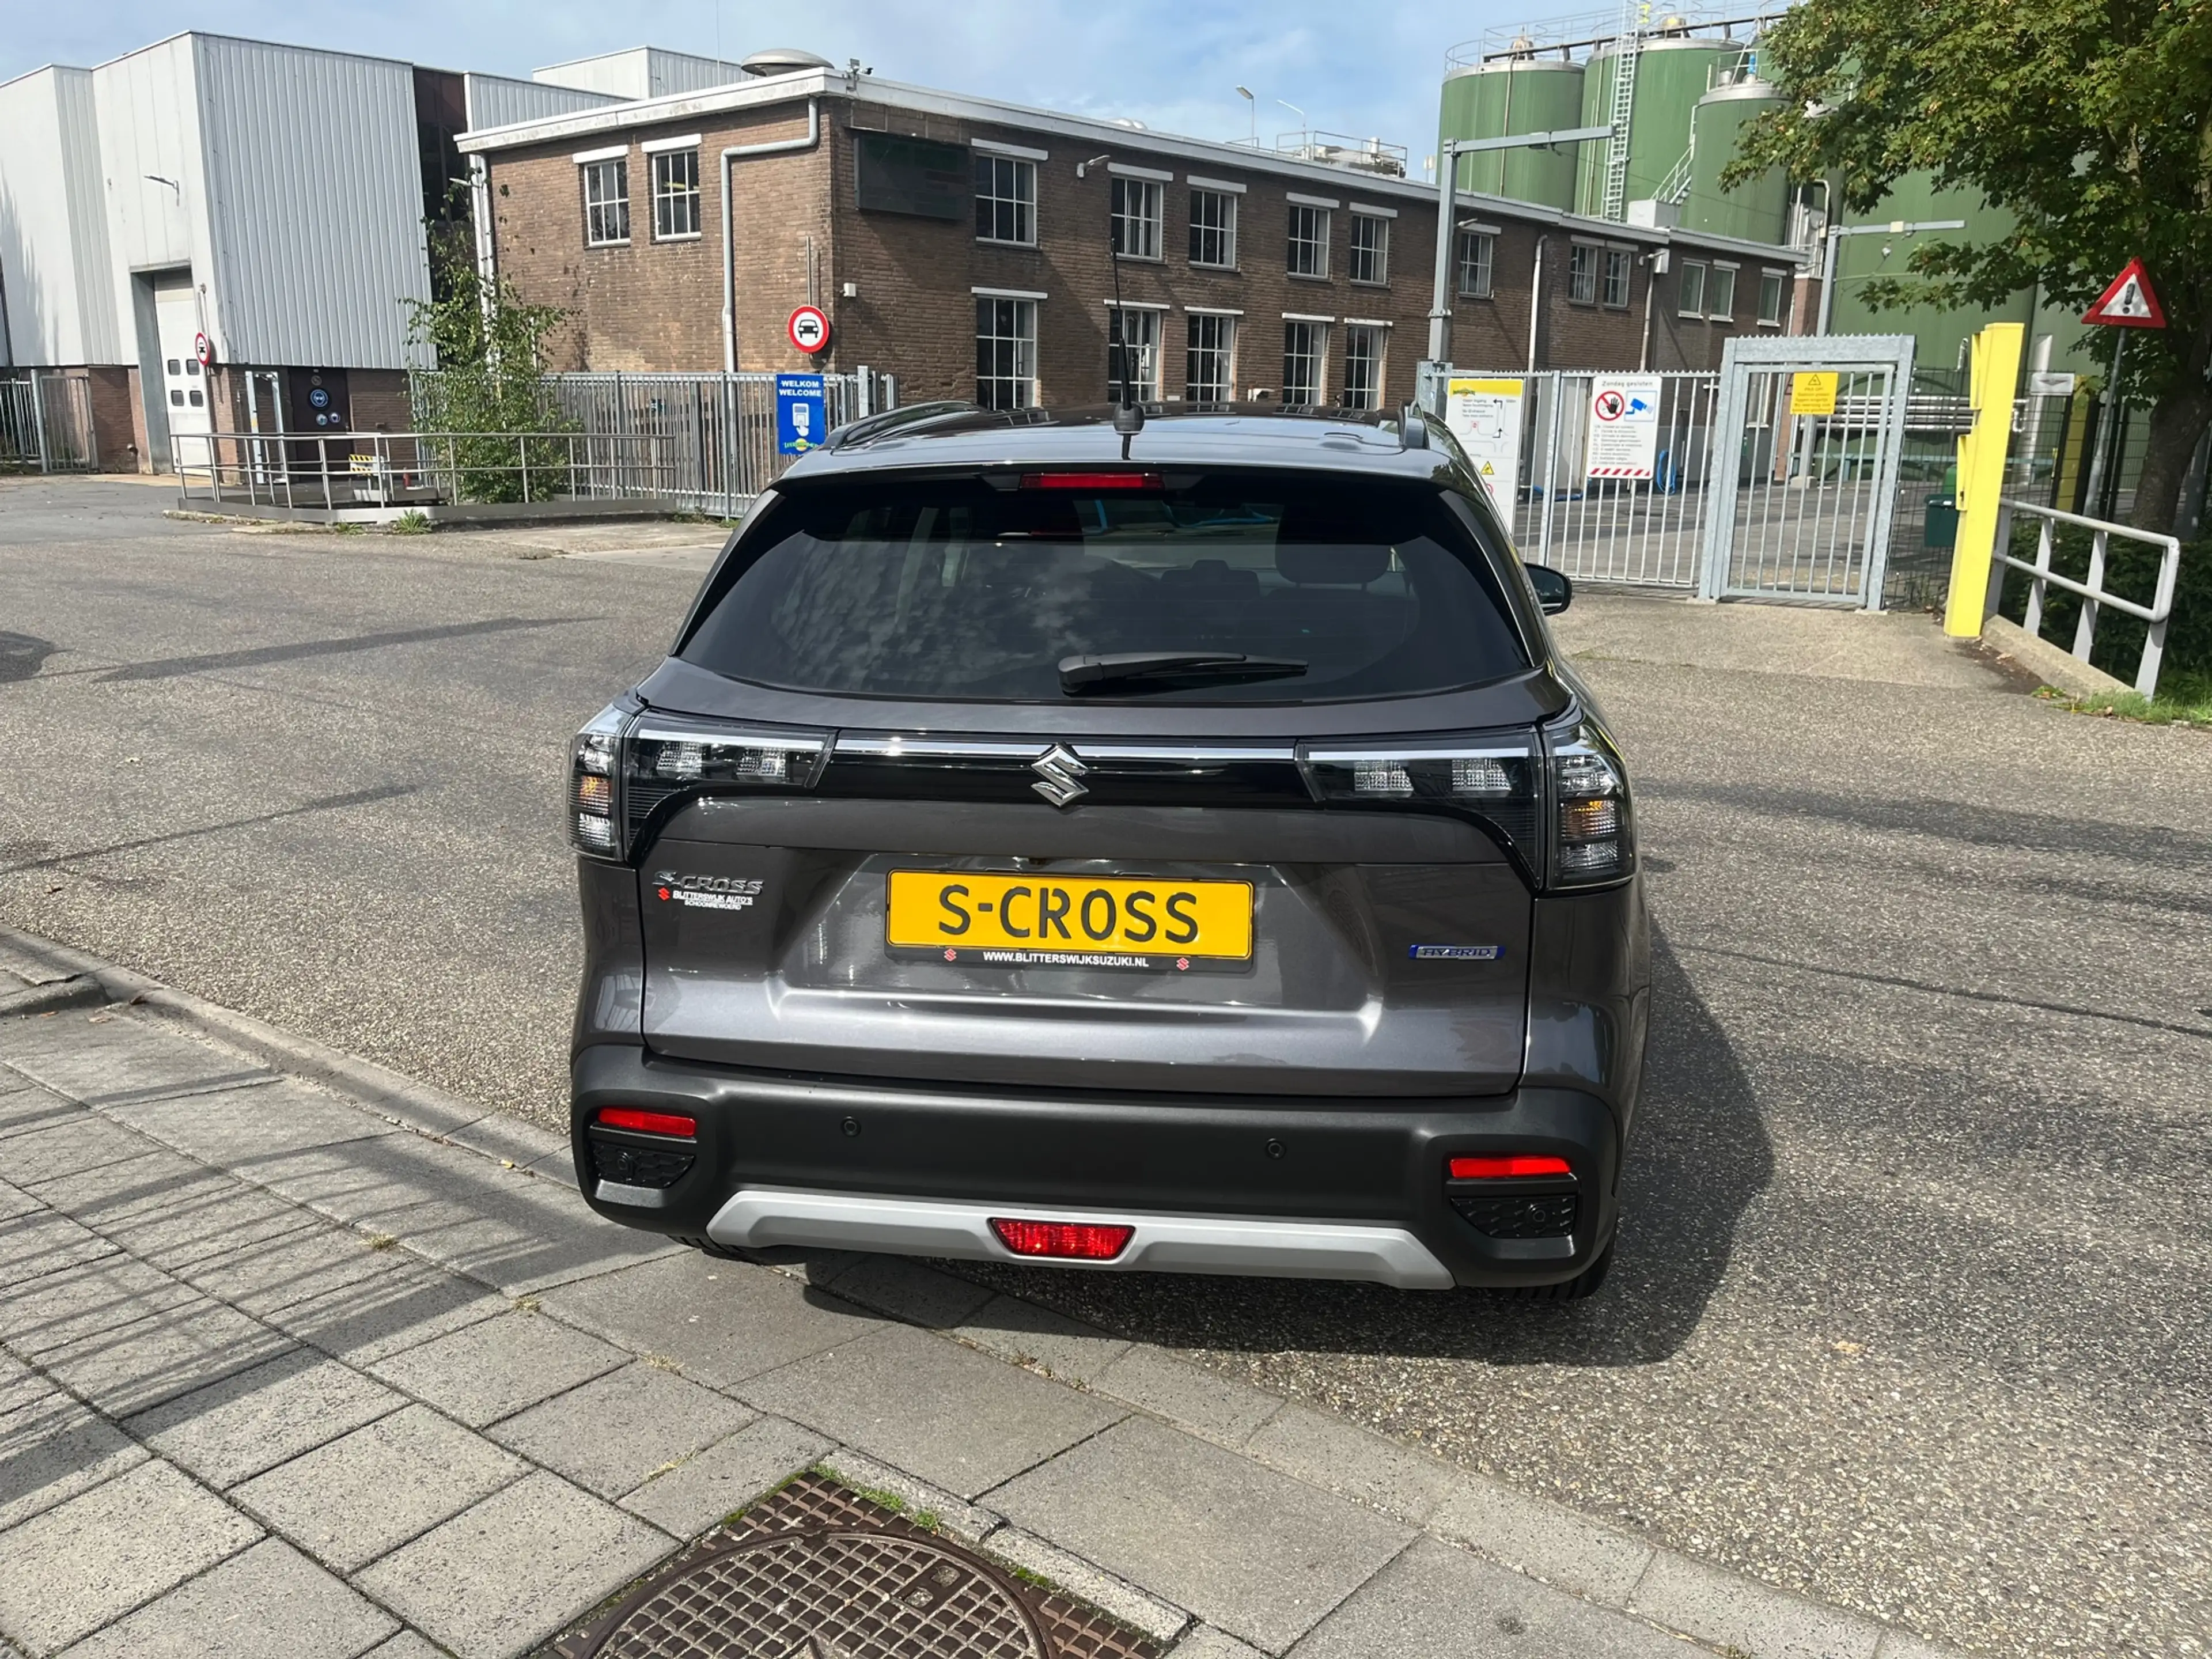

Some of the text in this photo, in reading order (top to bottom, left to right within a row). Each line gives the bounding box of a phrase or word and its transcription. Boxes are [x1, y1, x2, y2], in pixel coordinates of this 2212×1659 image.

[779, 389, 822, 397] WELCOME
[652, 870, 764, 895] S-CROSS
[938, 884, 1199, 944] S-CROSS
[983, 950, 1149, 968] WWW.BLITTERSWIJKSUZUKI.NL
[1423, 948, 1491, 957] HYBRID
